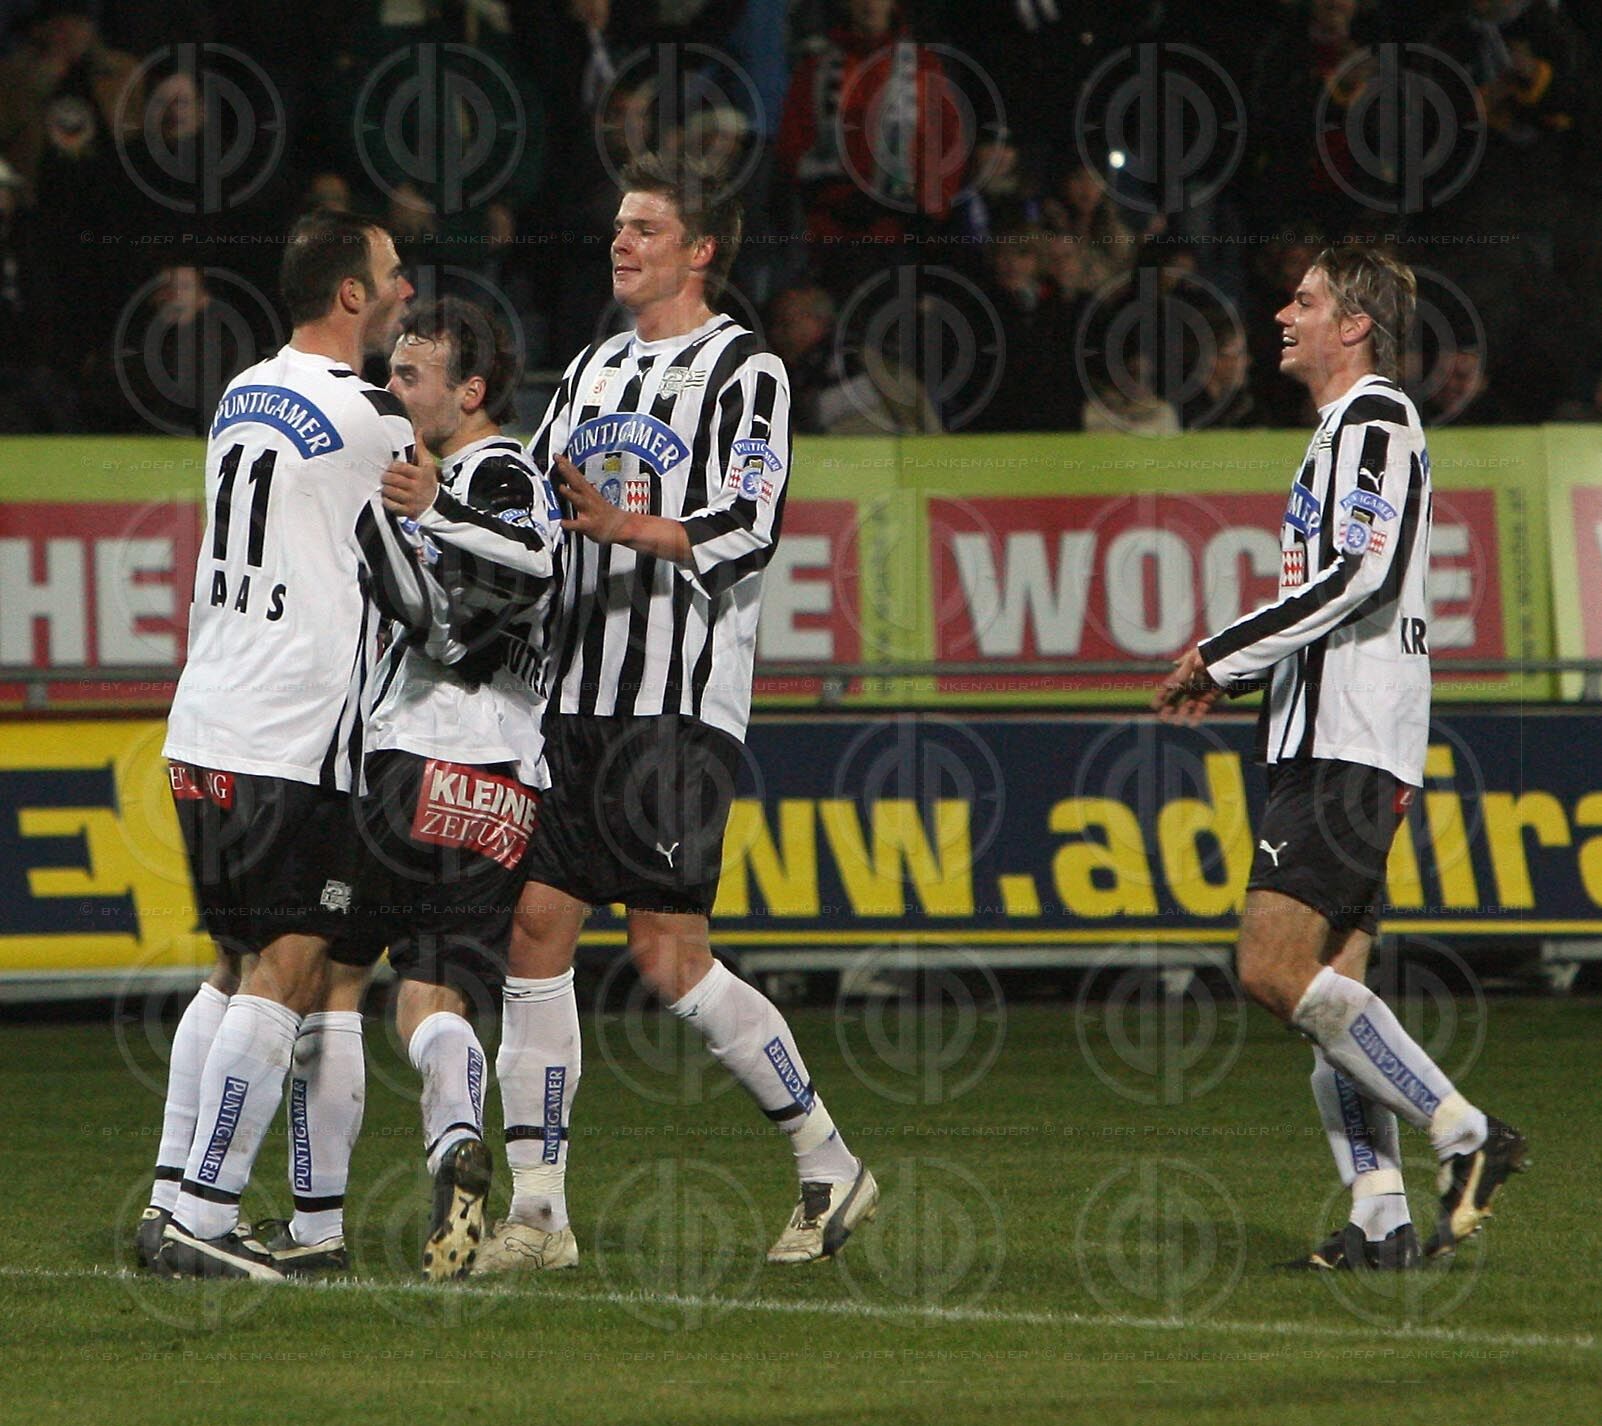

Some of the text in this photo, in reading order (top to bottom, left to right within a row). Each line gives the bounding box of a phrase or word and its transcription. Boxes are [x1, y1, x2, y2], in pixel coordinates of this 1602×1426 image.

[212, 443, 278, 567] 11
[189, 569, 287, 621] AAS
[952, 522, 1476, 660] WOCE
[429, 769, 537, 834] KLEINE
[199, 1078, 248, 1180] PUNTIGAMER
[545, 1070, 563, 1164] UNTIGAMER
